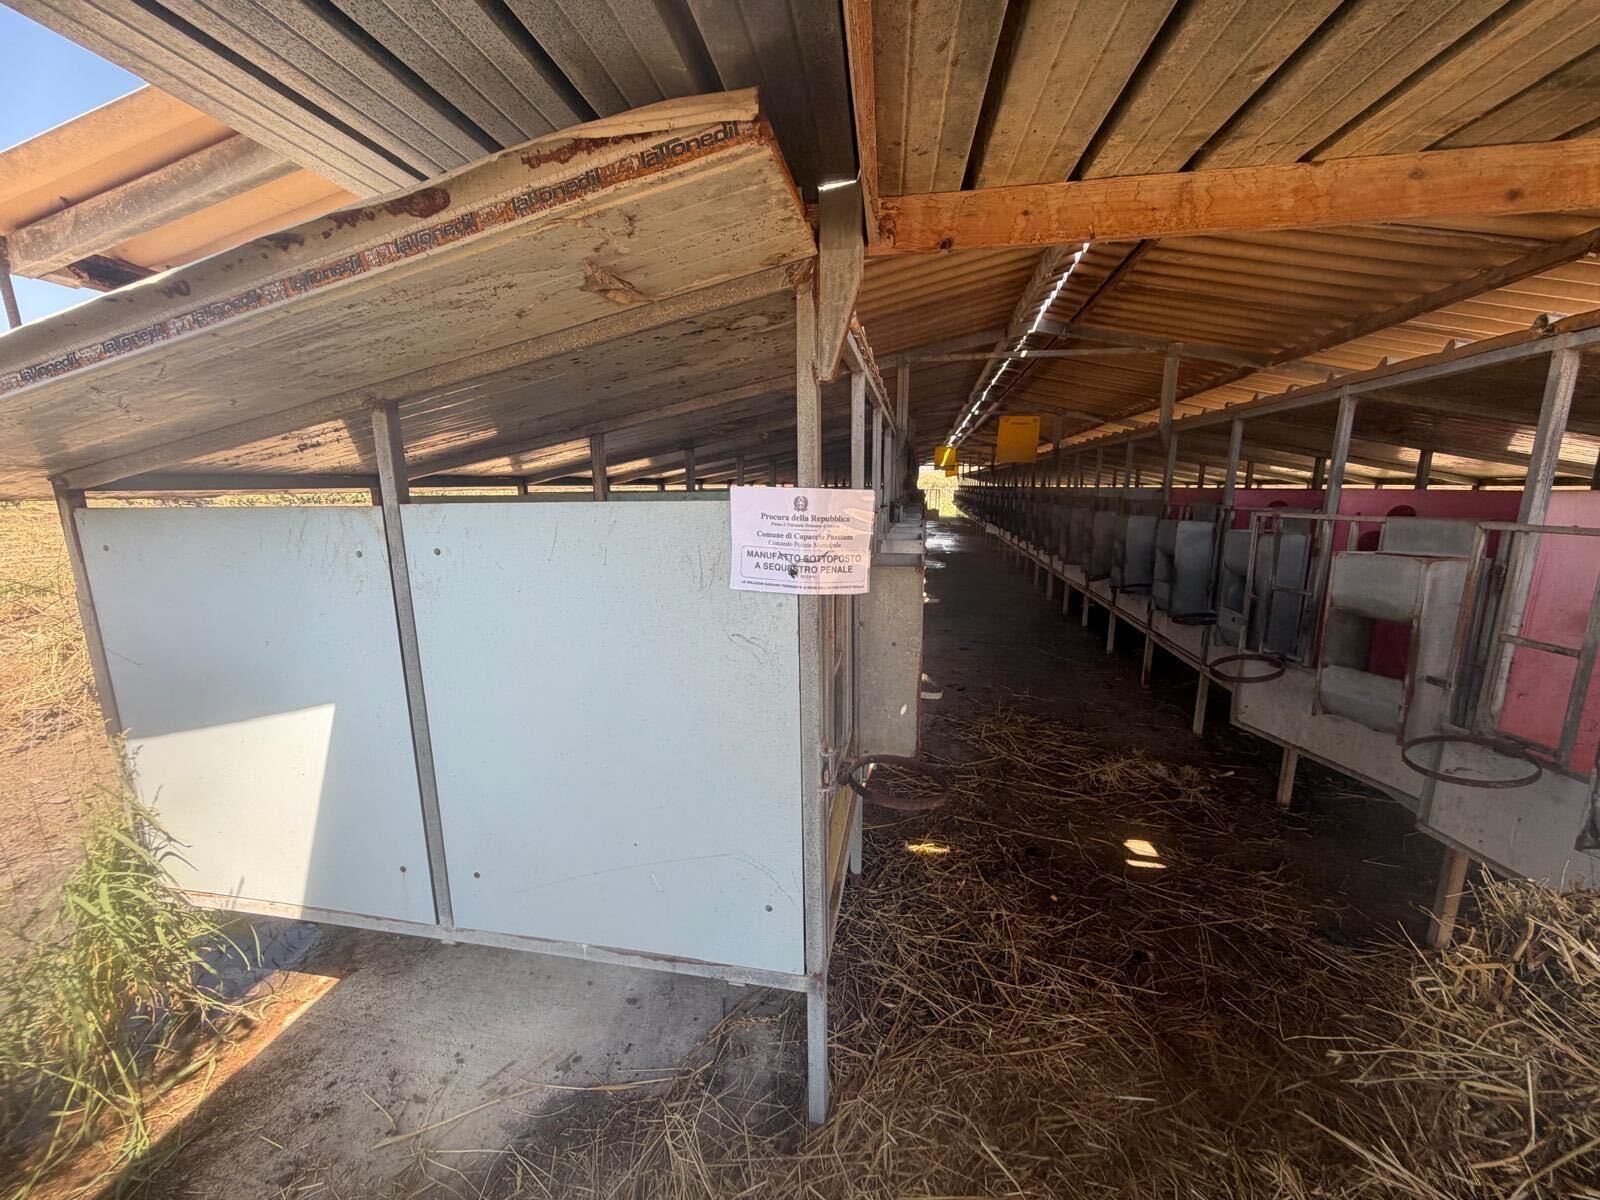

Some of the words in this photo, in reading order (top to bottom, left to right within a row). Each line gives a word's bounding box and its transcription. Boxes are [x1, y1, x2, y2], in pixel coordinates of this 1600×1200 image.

[760, 512, 789, 522] Procura
[791, 513, 809, 523] della
[811, 515, 850, 525] Repubblica
[756, 530, 785, 539] Comune
[786, 531, 792, 540] di
[746, 549, 801, 563] MANUFATTO
[803, 554, 862, 564] SOTTOPOSTO
[754, 561, 761, 570] A
[763, 562, 818, 574] SEQUESTRO
[820, 565, 854, 574] PENALE
